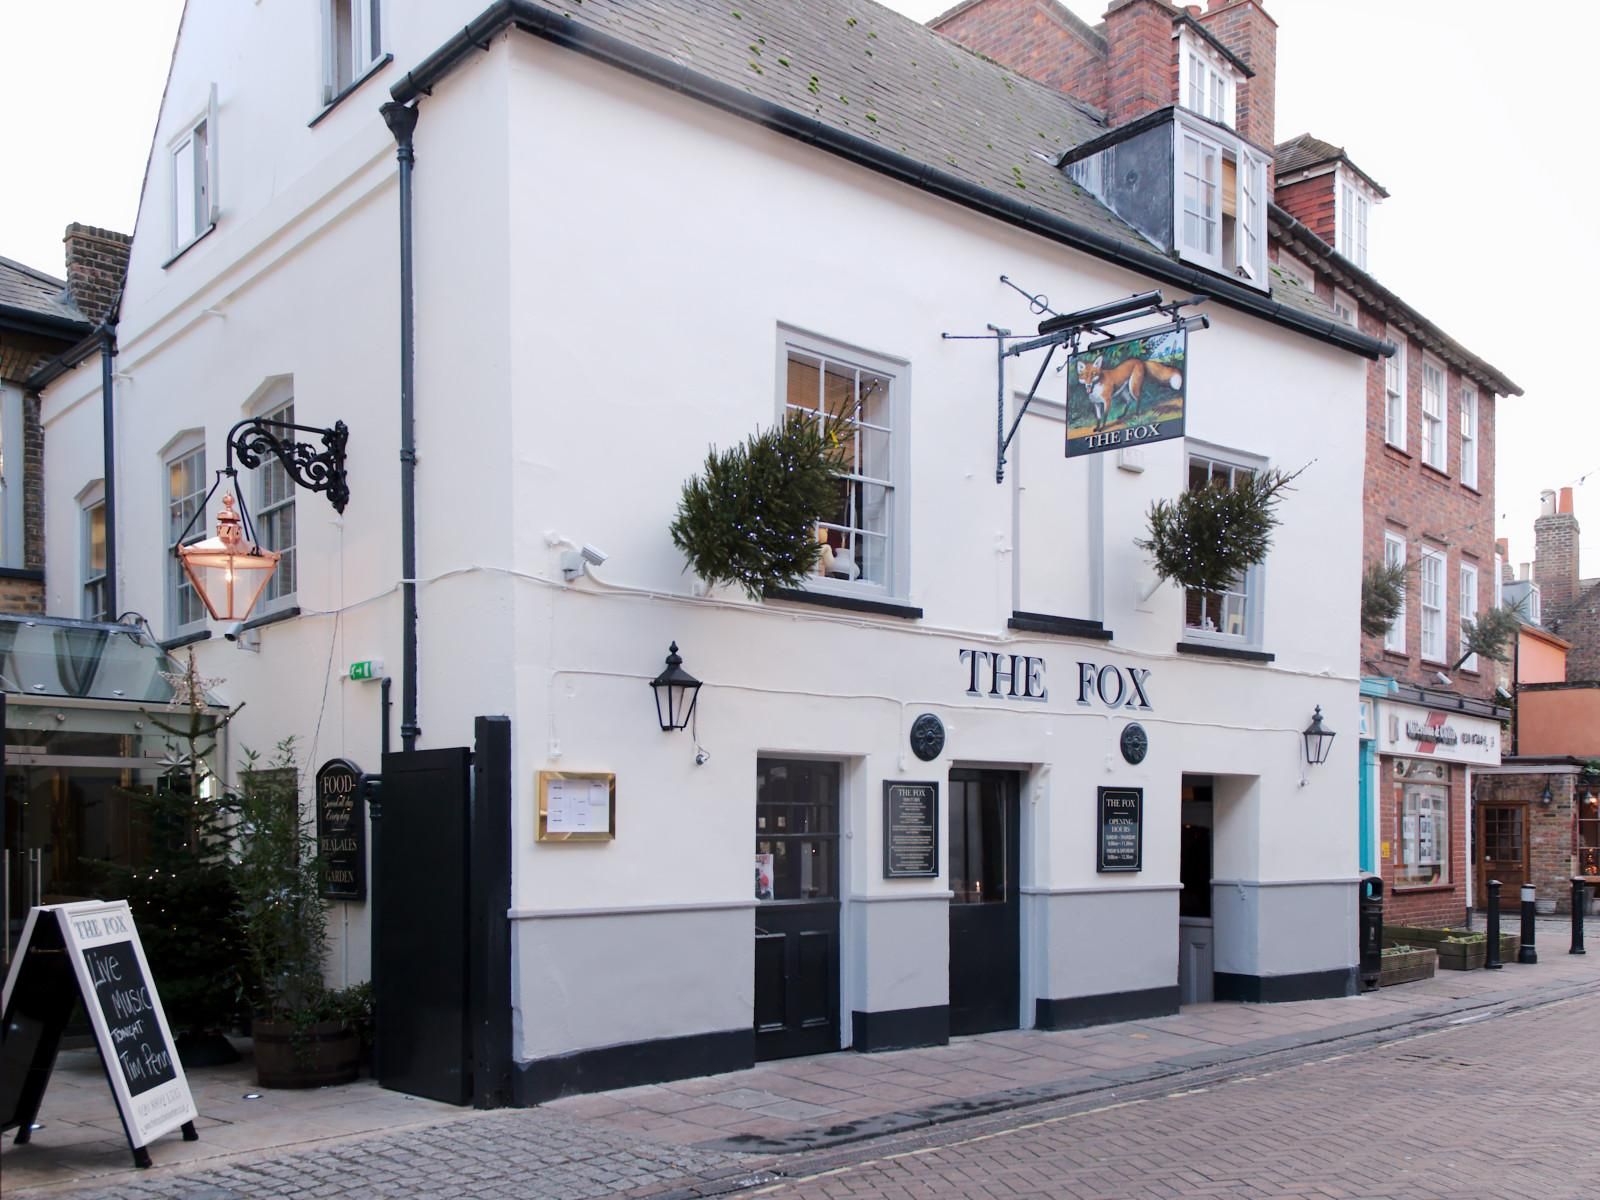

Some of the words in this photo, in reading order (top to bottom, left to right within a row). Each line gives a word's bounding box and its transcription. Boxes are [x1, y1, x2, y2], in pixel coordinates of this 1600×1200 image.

[1085, 430, 1120, 448] THE
[1125, 423, 1160, 441] FOX
[959, 648, 1048, 702] THE
[1075, 661, 1154, 712] FOX
[323, 775, 352, 794] FOOD
[1106, 799, 1120, 807] THE
[1122, 799, 1136, 808] FOX
[321, 839, 339, 852] REAL
[339, 838, 358, 851] ALES
[325, 870, 354, 882] GARDEN
[73, 919, 102, 940] THE
[104, 916, 128, 934] FOX
[87, 953, 122, 989] Live
[110, 1021, 144, 1043] TONIGHT
